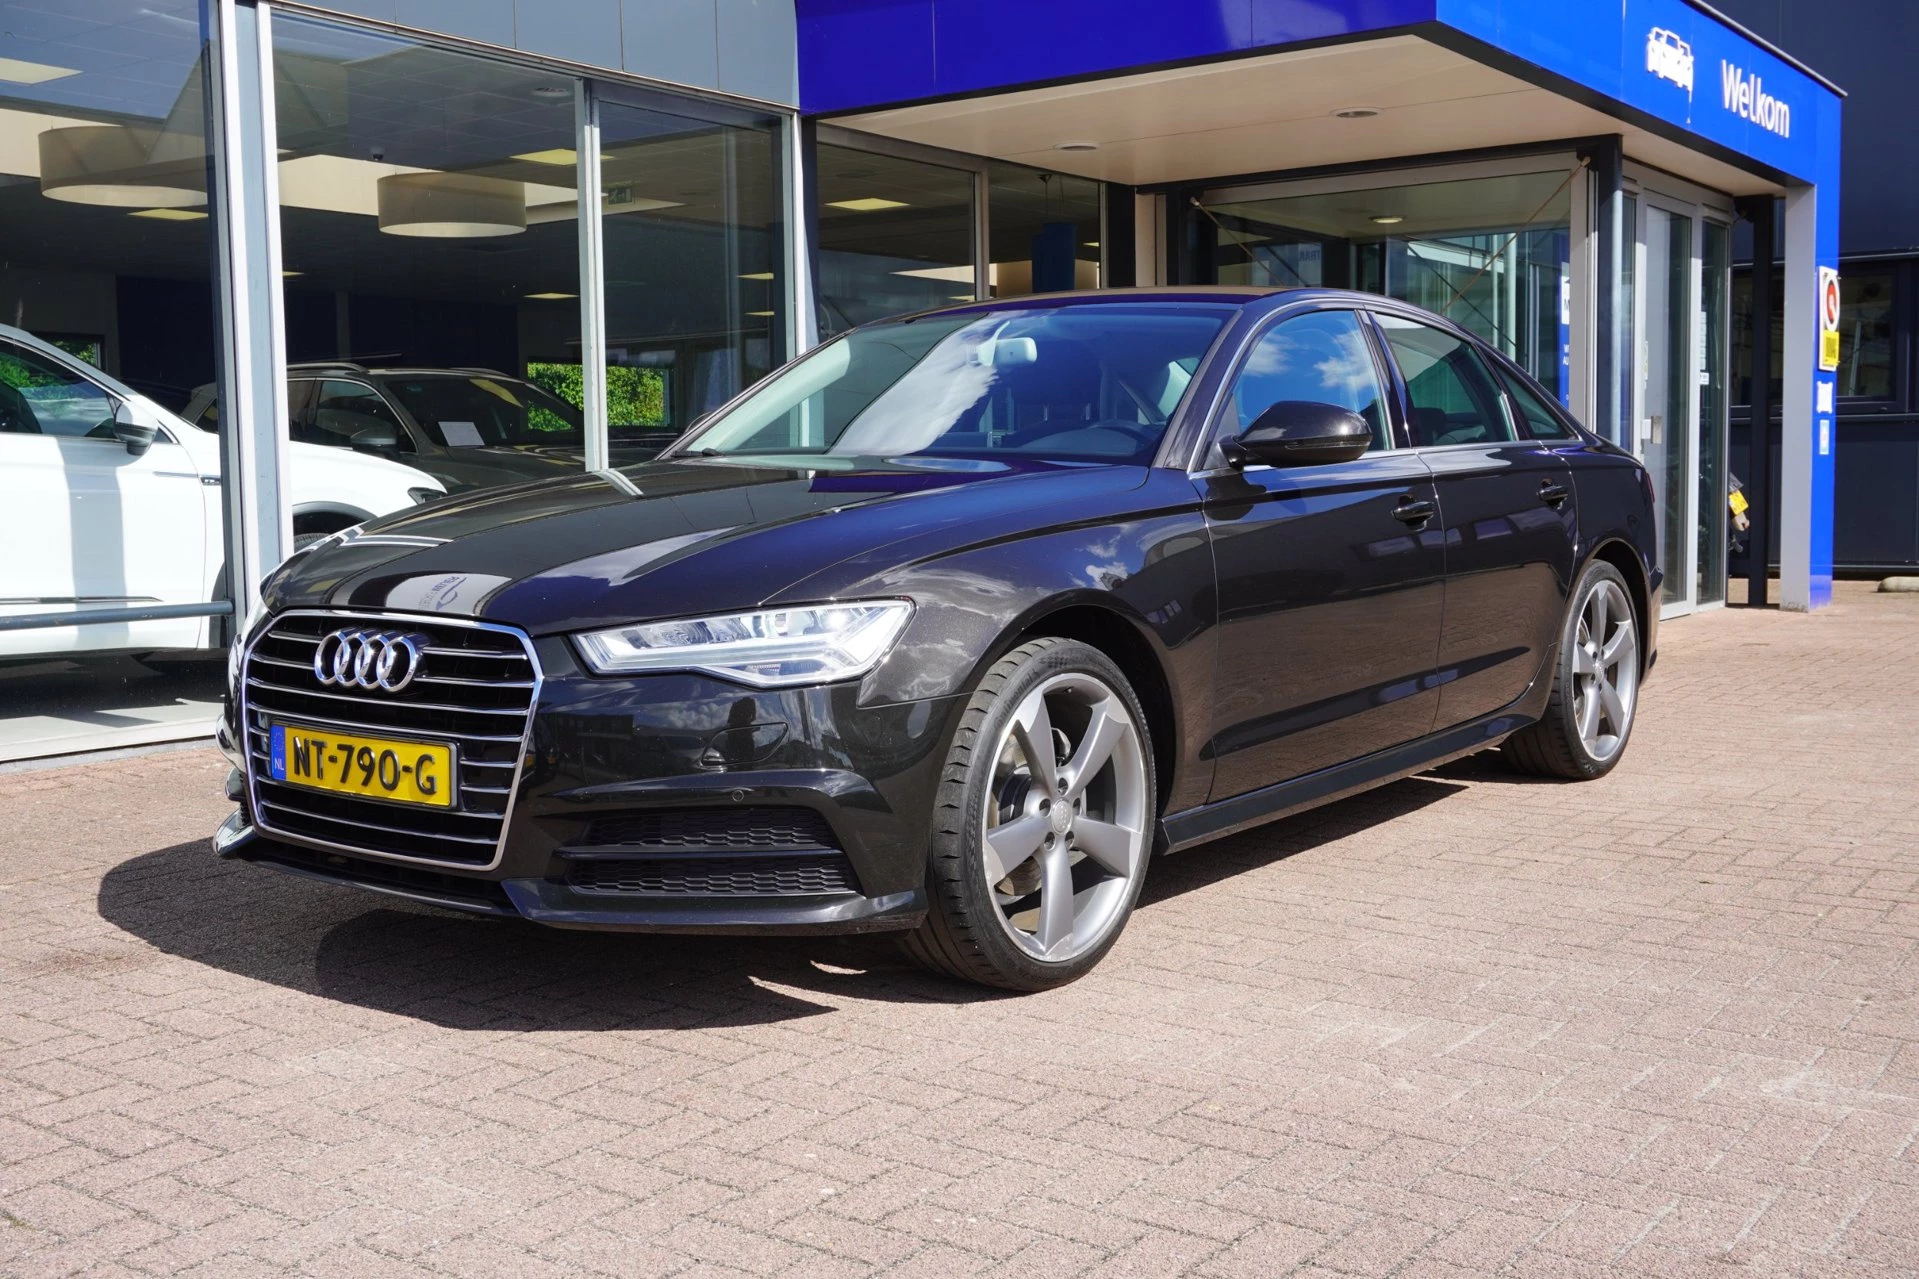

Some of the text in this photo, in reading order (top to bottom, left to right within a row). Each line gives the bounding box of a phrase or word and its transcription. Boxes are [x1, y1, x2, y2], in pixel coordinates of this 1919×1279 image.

[1721, 59, 1790, 138] Welkom
[274, 757, 285, 771] NL
[293, 736, 437, 795] NT-790-G
